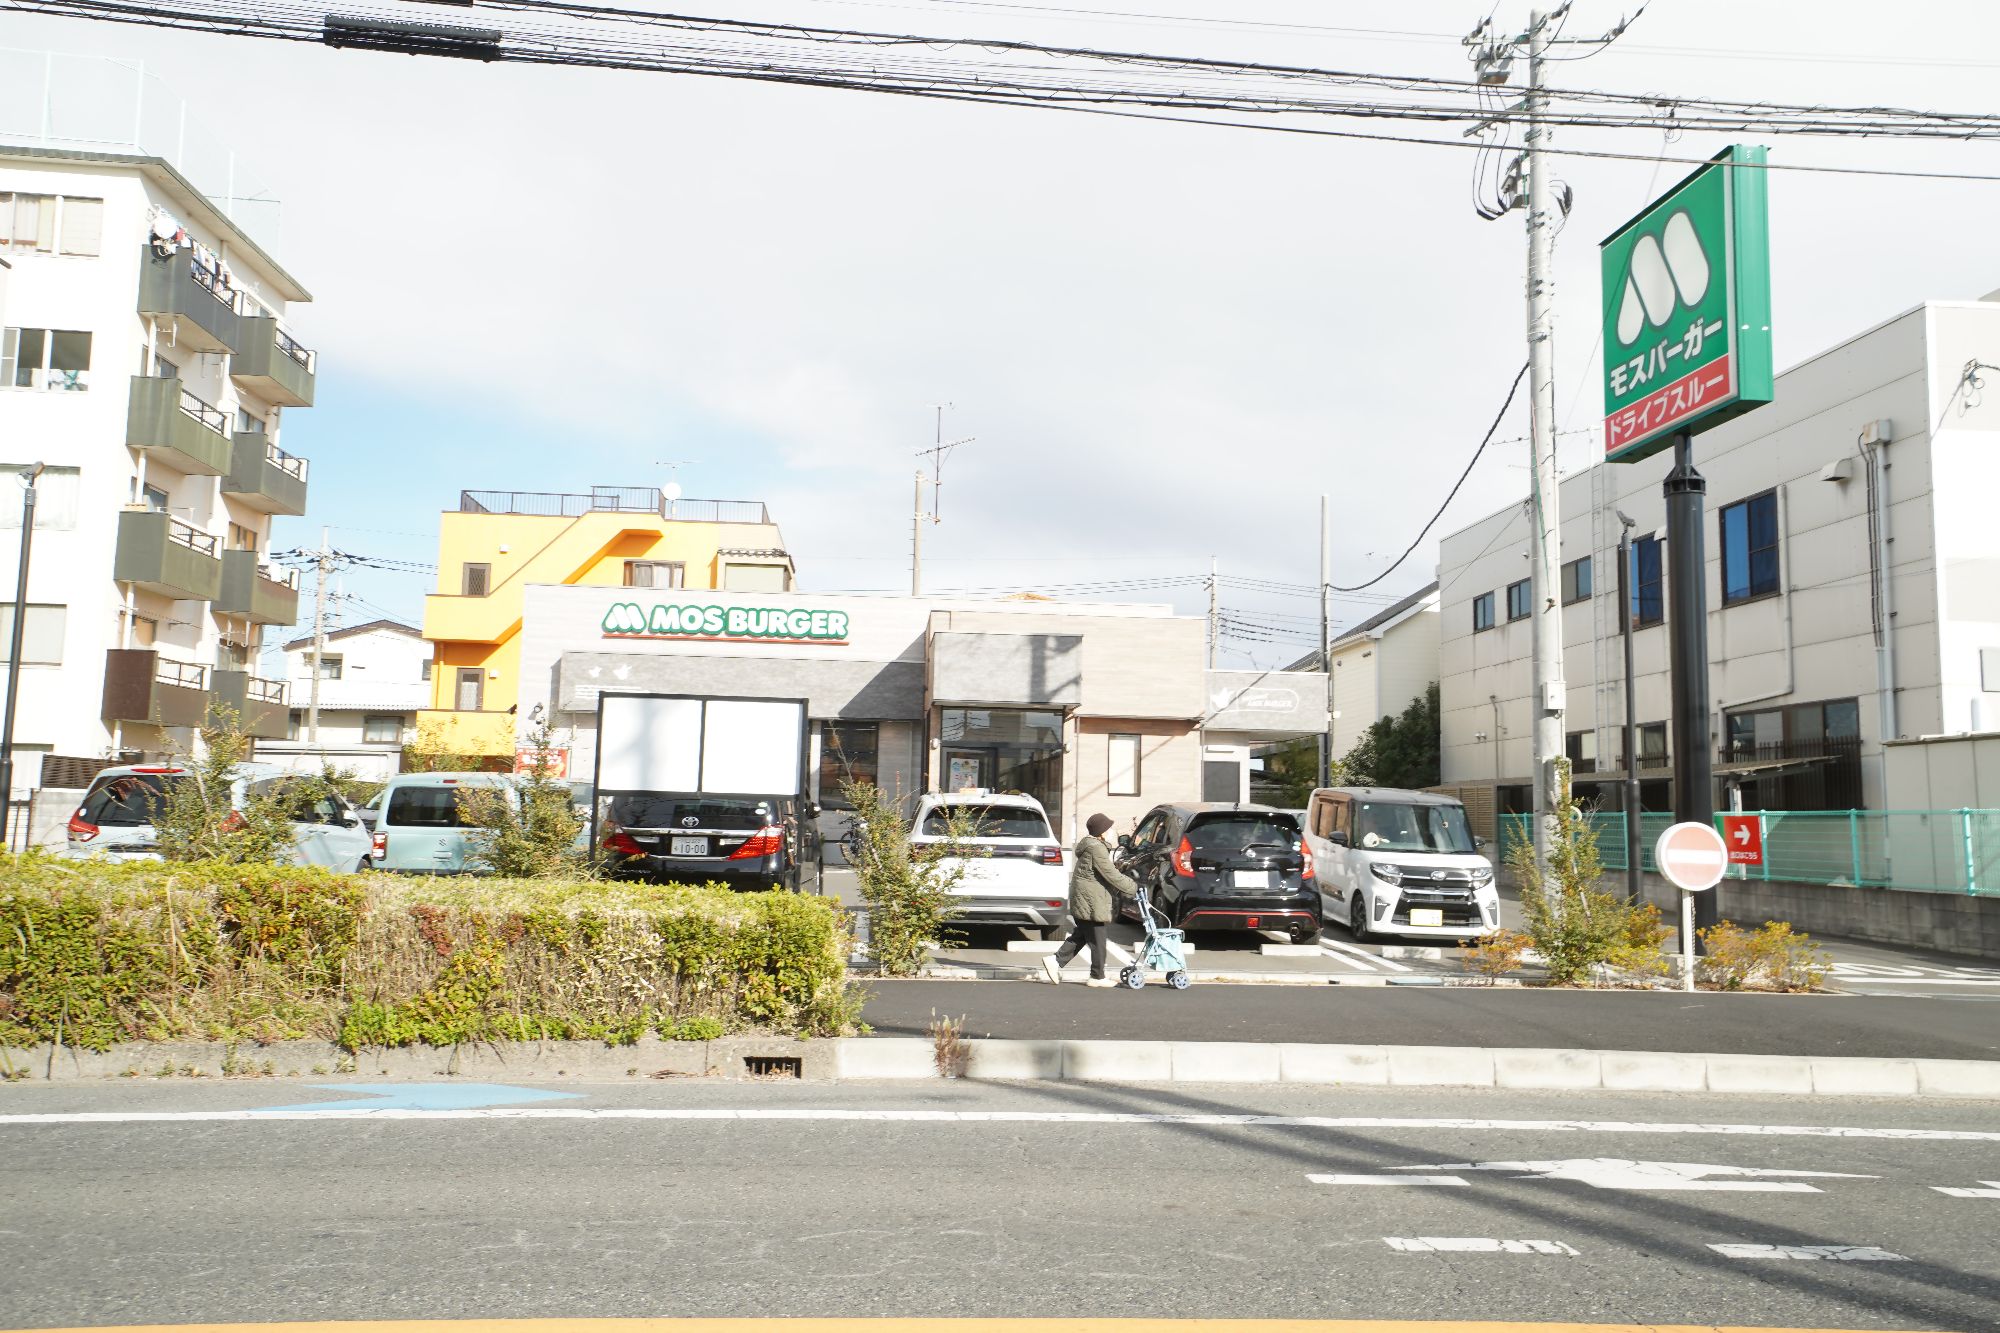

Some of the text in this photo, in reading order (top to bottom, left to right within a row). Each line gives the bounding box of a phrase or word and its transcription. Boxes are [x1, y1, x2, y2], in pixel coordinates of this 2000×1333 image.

[1610, 317, 1723, 396] モスバーガー
[1610, 374, 1724, 445] ドライブスルー
[651, 605, 725, 633] MOS
[727, 608, 848, 637] BURGER
